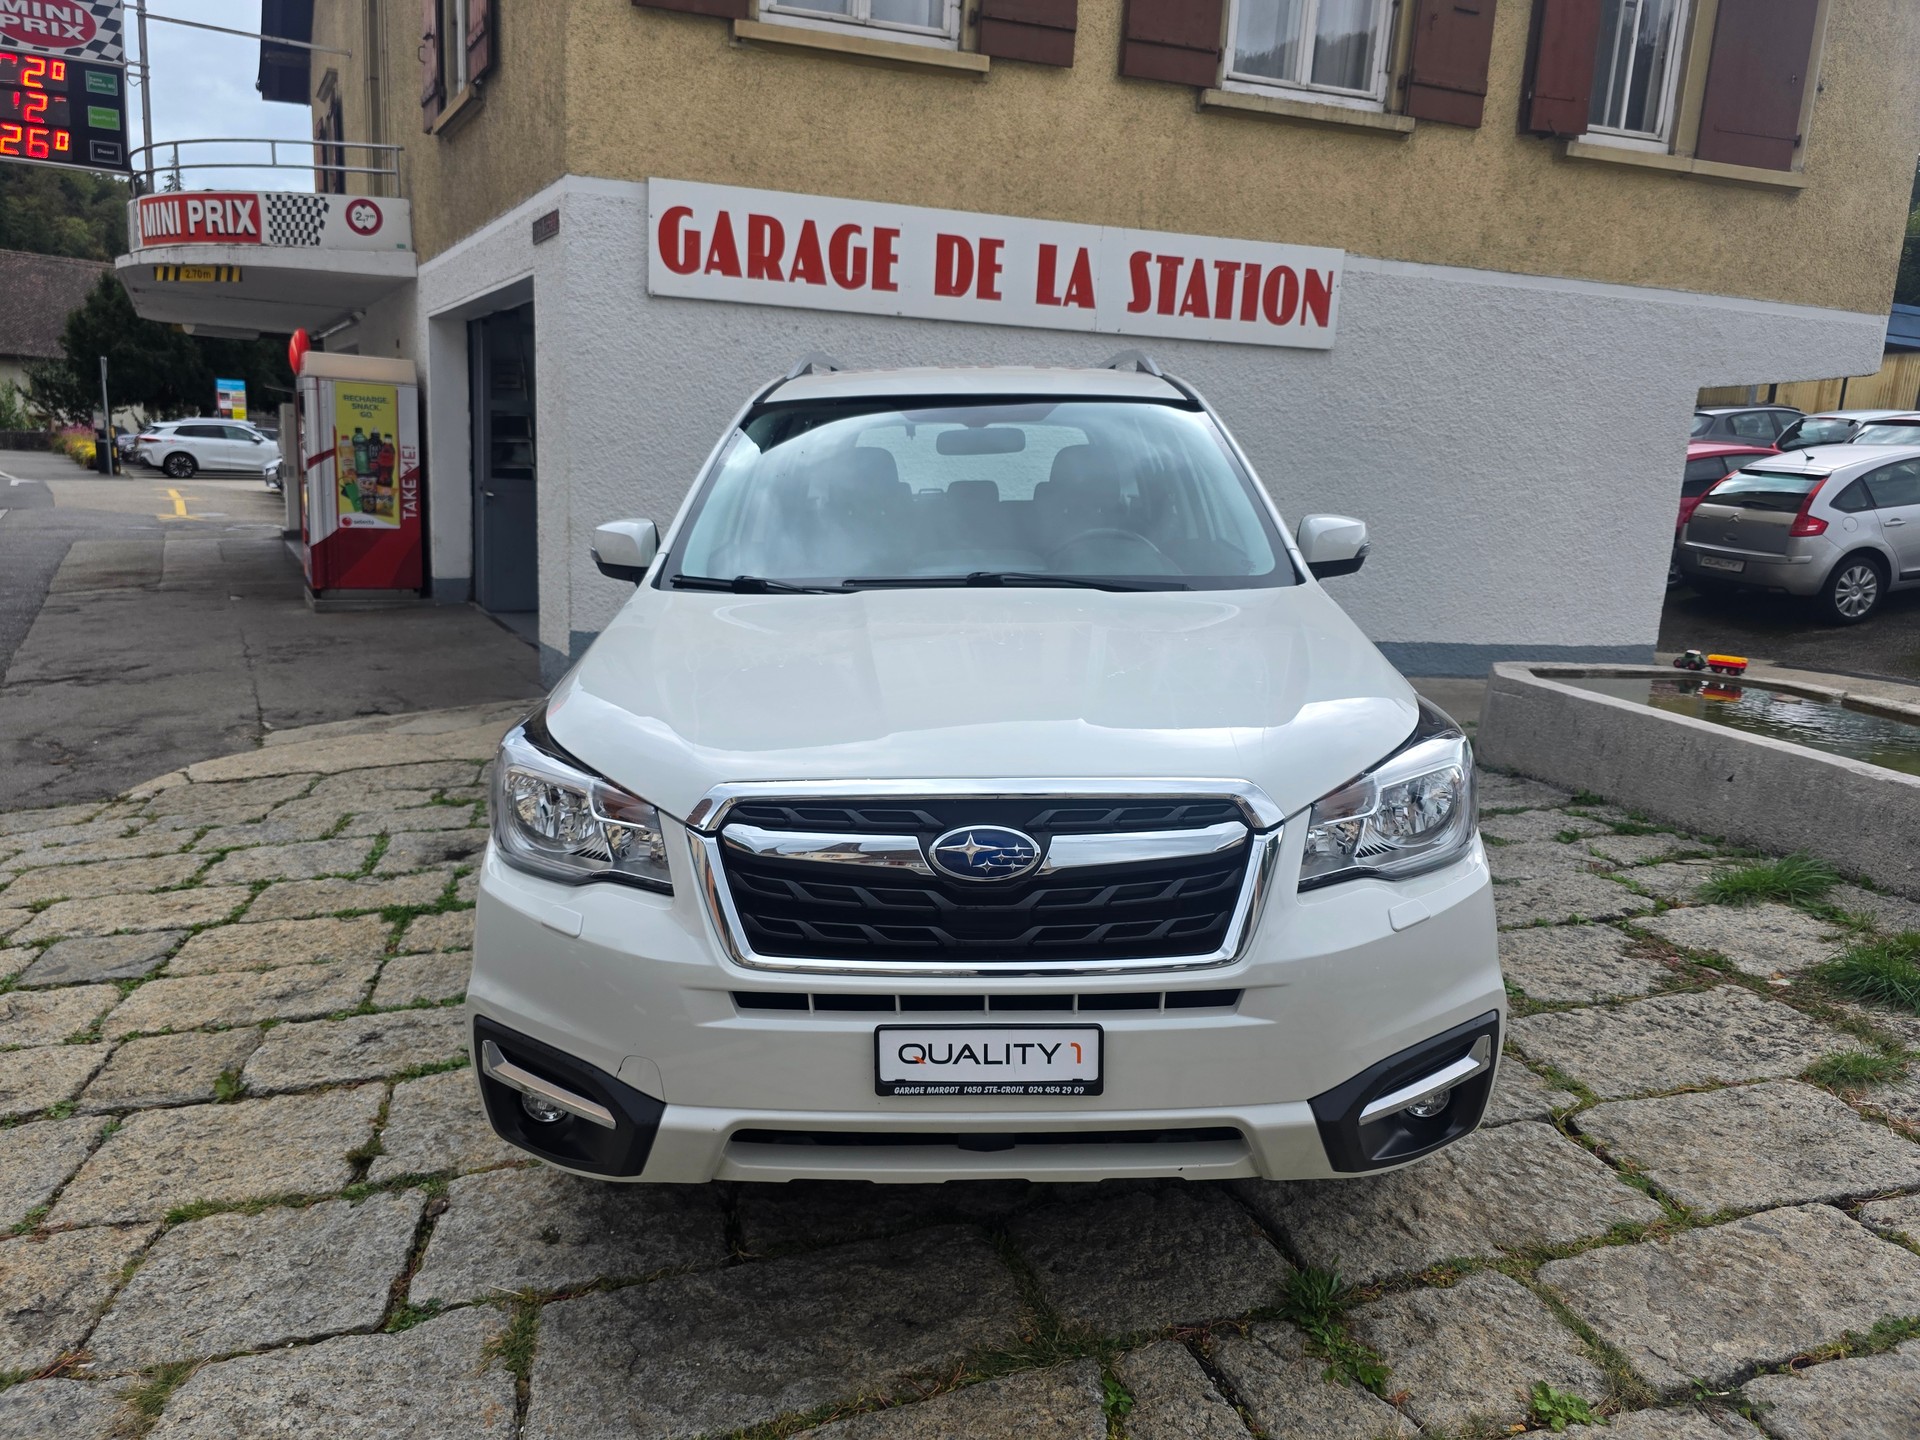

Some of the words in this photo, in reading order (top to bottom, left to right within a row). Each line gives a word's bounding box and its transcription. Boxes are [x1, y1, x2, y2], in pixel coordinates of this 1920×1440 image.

[0, 0, 84, 25] MINI
[0, 13, 86, 41] PRIX
[142, 200, 182, 238] MINI
[187, 199, 257, 234] PRIX
[658, 205, 901, 293] GARAGE
[934, 233, 1005, 301] DE
[1035, 243, 1096, 309] LA
[1127, 250, 1334, 328] STATION
[402, 445, 416, 477] ME!
[402, 479, 418, 519] TAKE
[898, 1043, 1062, 1065] QUALITY
[1070, 1042, 1082, 1064] 1
[894, 1086, 925, 1095] GARAGE
[926, 1086, 960, 1095] MARGOT
[963, 1086, 982, 1094] 1450
[983, 1086, 1025, 1094] STE-CROIX
[1028, 1086, 1043, 1094] 024
[1044, 1086, 1060, 1094] 454
[1061, 1086, 1072, 1094] 29
[1073, 1086, 1085, 1095] 09
